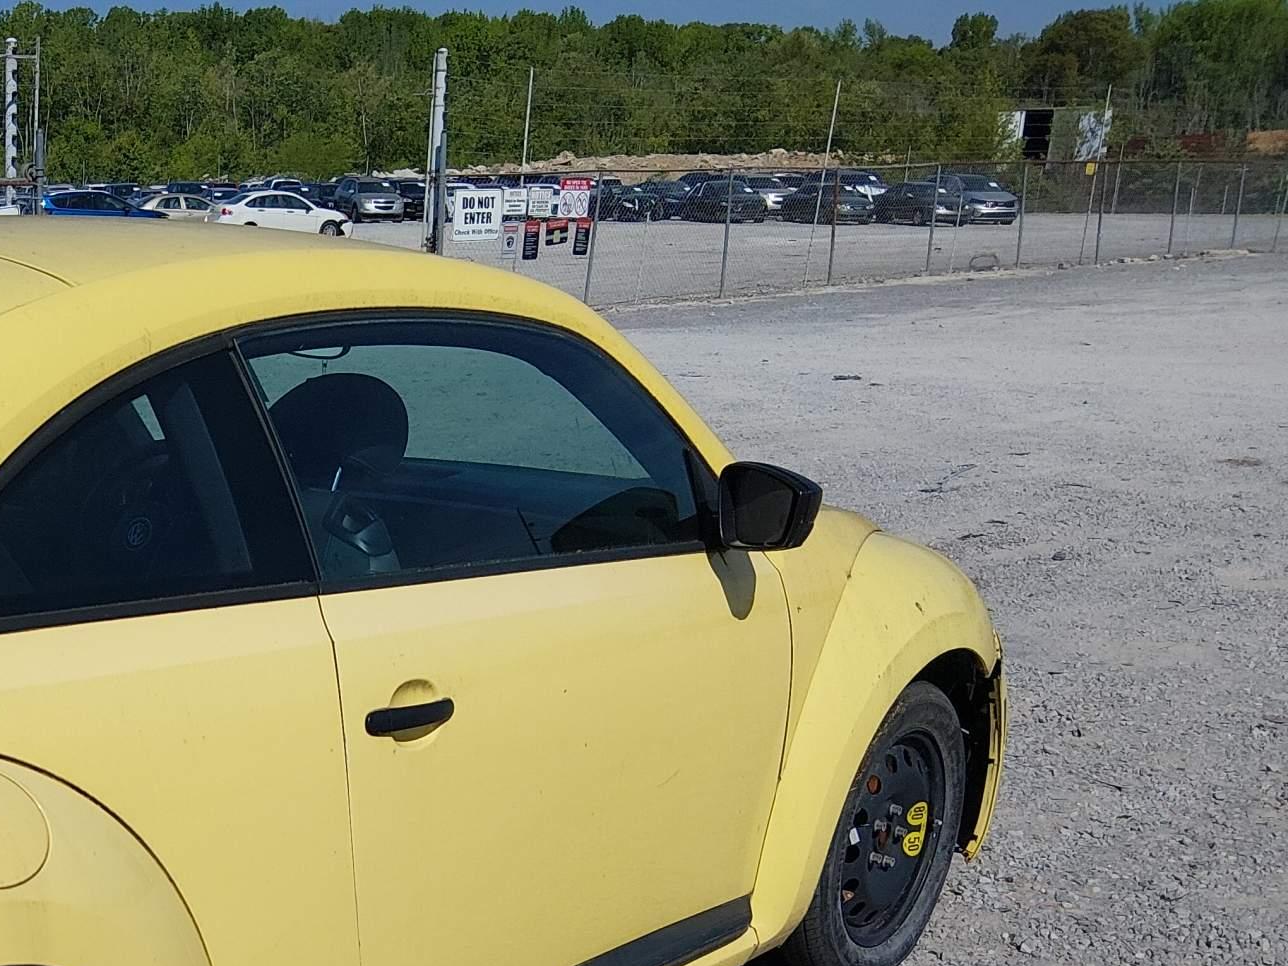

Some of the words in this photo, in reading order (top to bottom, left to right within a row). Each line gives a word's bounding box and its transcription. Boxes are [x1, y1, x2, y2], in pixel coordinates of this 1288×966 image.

[462, 196, 475, 209] DO
[477, 196, 496, 209] NOT
[464, 211, 492, 225] ENTER
[454, 228, 470, 236] Check
[484, 227, 499, 235] Office
[911, 806, 925, 820] 80
[908, 836, 920, 851] 50
